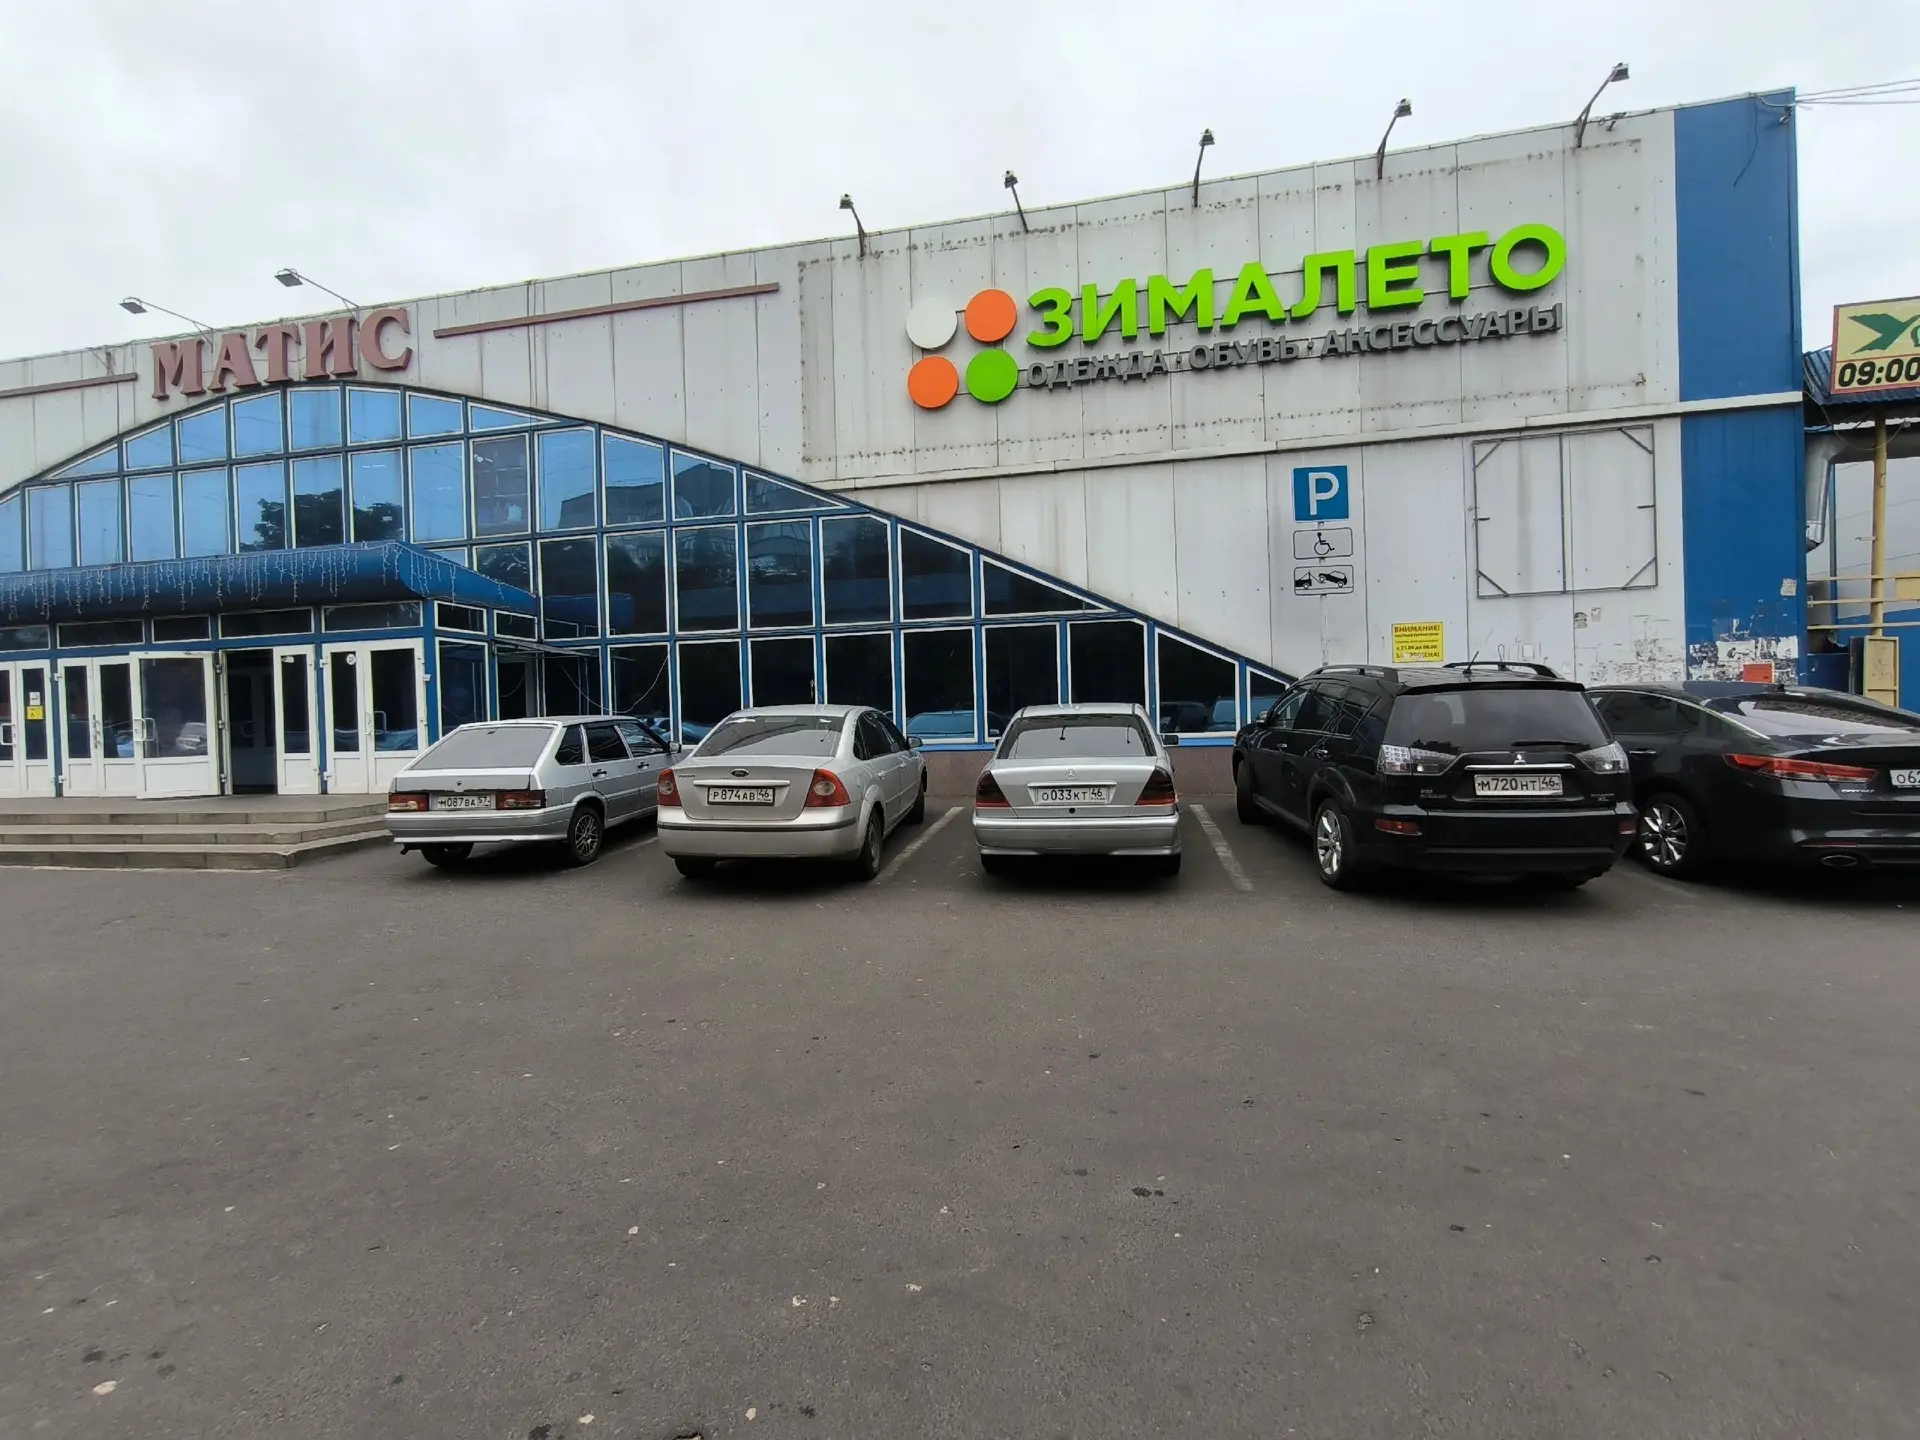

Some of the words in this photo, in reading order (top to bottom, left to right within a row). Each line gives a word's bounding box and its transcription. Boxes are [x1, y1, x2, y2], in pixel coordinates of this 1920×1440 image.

[1026, 223, 1567, 347] ЗИМАЛЕТО
[150, 308, 413, 400] МАТИС
[1027, 349, 1169, 391] ОДЕЖДА
[1188, 335, 1300, 371] ОБУВЬ
[1321, 302, 1563, 358] АКСЕССУАРЫ
[1838, 357, 1920, 387] 09:00
[1308, 472, 1340, 516] P
[1394, 625, 1440, 633] ВНИМАНИЕ!
[713, 789, 756, 801] Р874АВ
[1041, 789, 1088, 801] О033КТ
[1481, 778, 1537, 791] М720НТ
